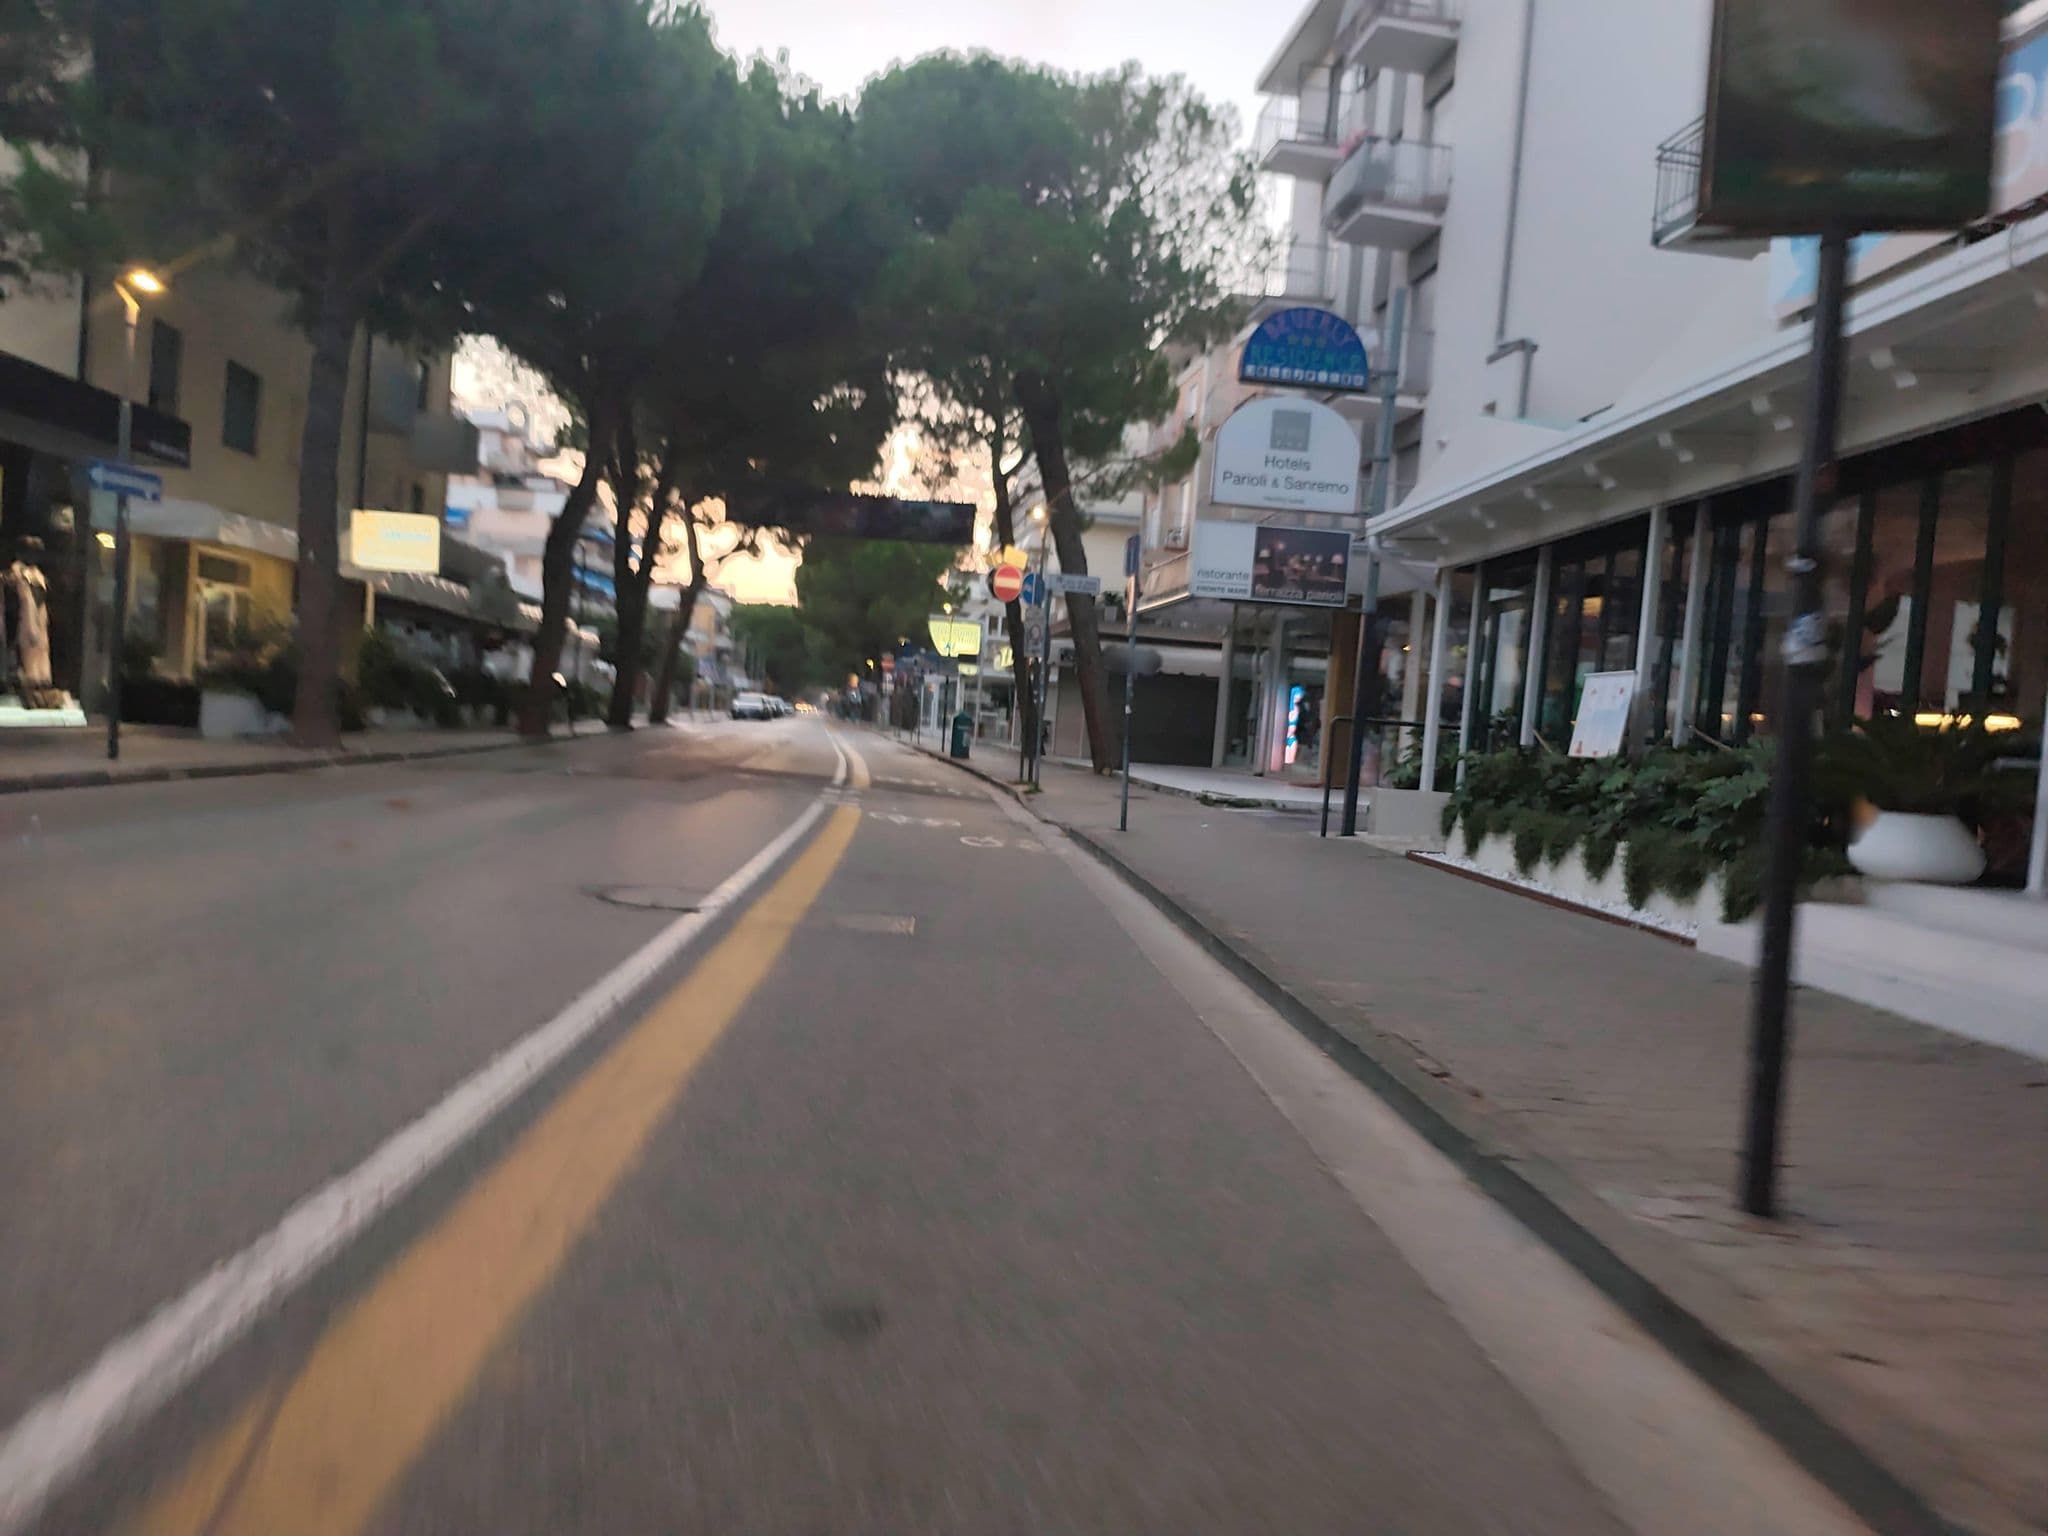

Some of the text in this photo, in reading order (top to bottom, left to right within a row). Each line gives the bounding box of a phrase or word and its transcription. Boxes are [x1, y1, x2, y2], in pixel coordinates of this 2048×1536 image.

[1264, 455, 1311, 472] Hotels
[1222, 470, 1349, 495] Parioli & Sanremo
[1197, 568, 1249, 581] ristorante
